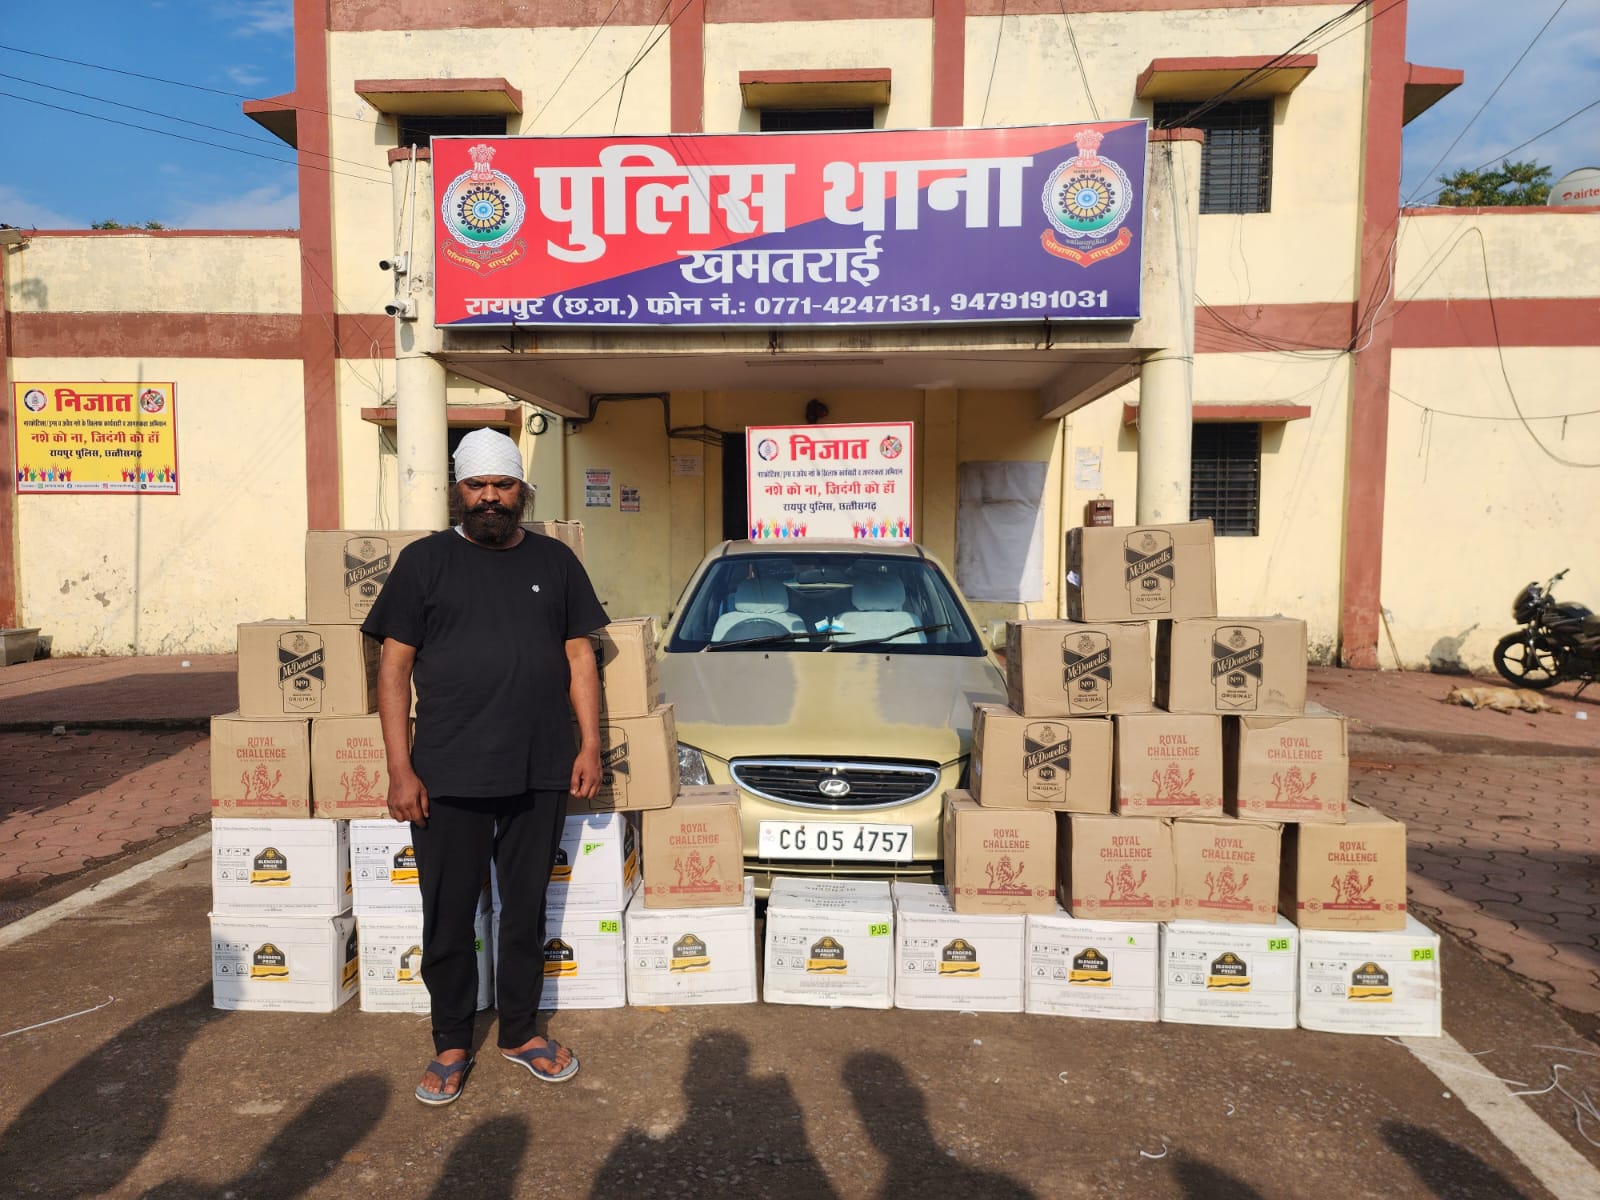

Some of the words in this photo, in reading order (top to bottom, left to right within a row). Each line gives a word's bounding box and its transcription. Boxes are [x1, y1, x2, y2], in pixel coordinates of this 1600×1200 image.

[533, 144, 795, 263] पुलिस
[822, 156, 1033, 231] थाना
[676, 234, 884, 287] खमतराई
[464, 297, 546, 320] रायपुर
[552, 294, 639, 319] (छ.ग.)
[645, 291, 703, 316] फोन
[754, 293, 941, 316] 0771-4247131,
[950, 289, 1109, 311] 9479191031
[54, 388, 133, 412] निजात
[31, 430, 49, 443] नशे
[52, 430, 67, 443] को
[70, 433, 87, 445] ना,
[129, 430, 145, 443] को
[789, 434, 869, 461] निजात
[50, 449, 73, 459] रायपुर
[75, 448, 102, 459] पुलिस,
[764, 482, 783, 496] नशे
[786, 482, 801, 495] को
[804, 484, 821, 497] ना,
[864, 481, 880, 494] को
[783, 503, 807, 514] रायपुर
[809, 501, 836, 513] पुलिस,
[1129, 551, 1171, 579] McDowell's
[348, 558, 389, 585] McDowell's
[247, 736, 275, 748] ROYAL
[346, 737, 374, 749] ROYAL
[1159, 734, 1188, 746] ROYAL
[1279, 737, 1310, 748] ROYAL
[236, 748, 287, 759] CHALLENGE
[335, 749, 385, 760] CHALLENGE
[1027, 743, 1068, 768] McDowell's
[1147, 746, 1200, 757] CHALLENGE
[1267, 749, 1323, 760] CHALLENGE
[680, 823, 708, 834] ROYAL
[993, 828, 1019, 839] ROYAL
[668, 834, 720, 845] CHALLENGE
[780, 829, 806, 850] CG
[817, 830, 843, 851] 05
[853, 830, 908, 853] 4757
[983, 839, 1030, 849] CHALLENGE
[1111, 835, 1141, 846] ROYAL
[1214, 837, 1244, 849] ROYAL
[1339, 841, 1367, 852] ROYAL
[1100, 848, 1152, 858] CHALLENGE
[1201, 849, 1255, 862] CHALLENGE
[1327, 852, 1378, 863] CHALLENGE
[600, 921, 618, 932] PJB
[871, 924, 888, 935] PJB
[1269, 939, 1288, 950] PJB
[1413, 949, 1432, 960] PJB
